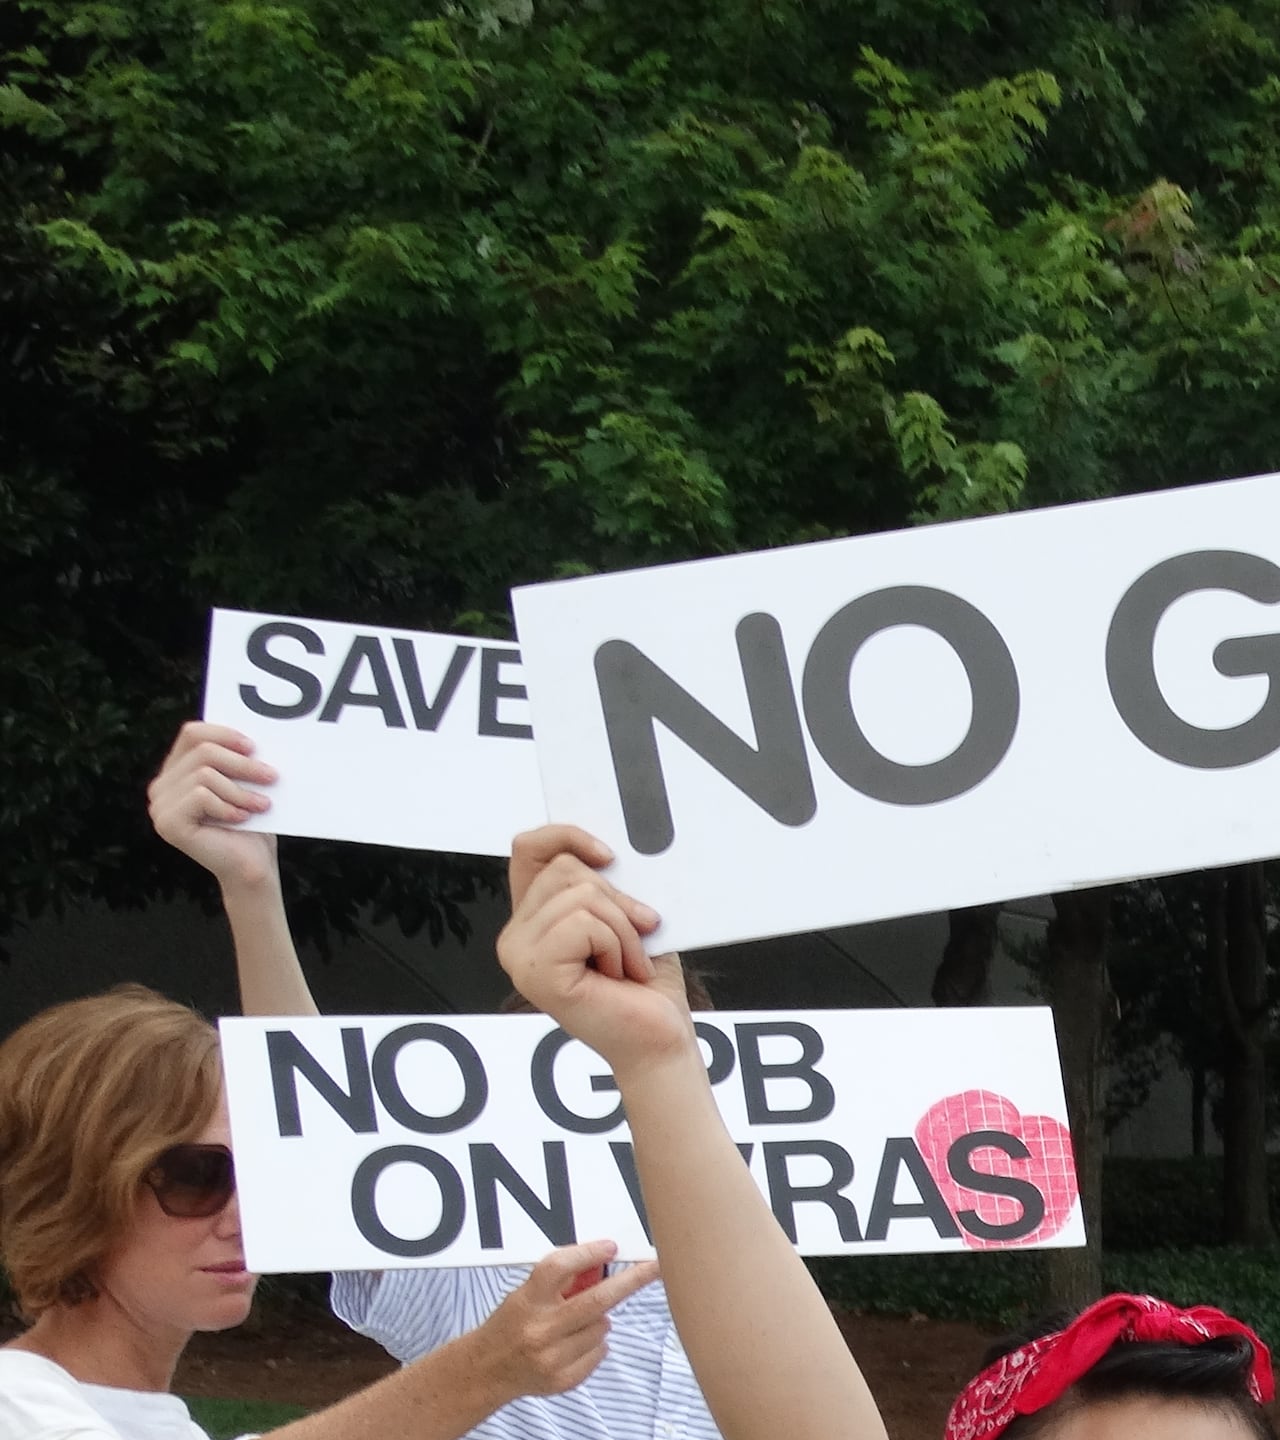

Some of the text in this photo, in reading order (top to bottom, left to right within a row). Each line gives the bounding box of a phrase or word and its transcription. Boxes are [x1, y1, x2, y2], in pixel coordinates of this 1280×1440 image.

[237, 621, 533, 740] SAVE
[593, 584, 1020, 856] NO
[266, 1022, 489, 1137] NO
[351, 1130, 1046, 1258] ON RAS
